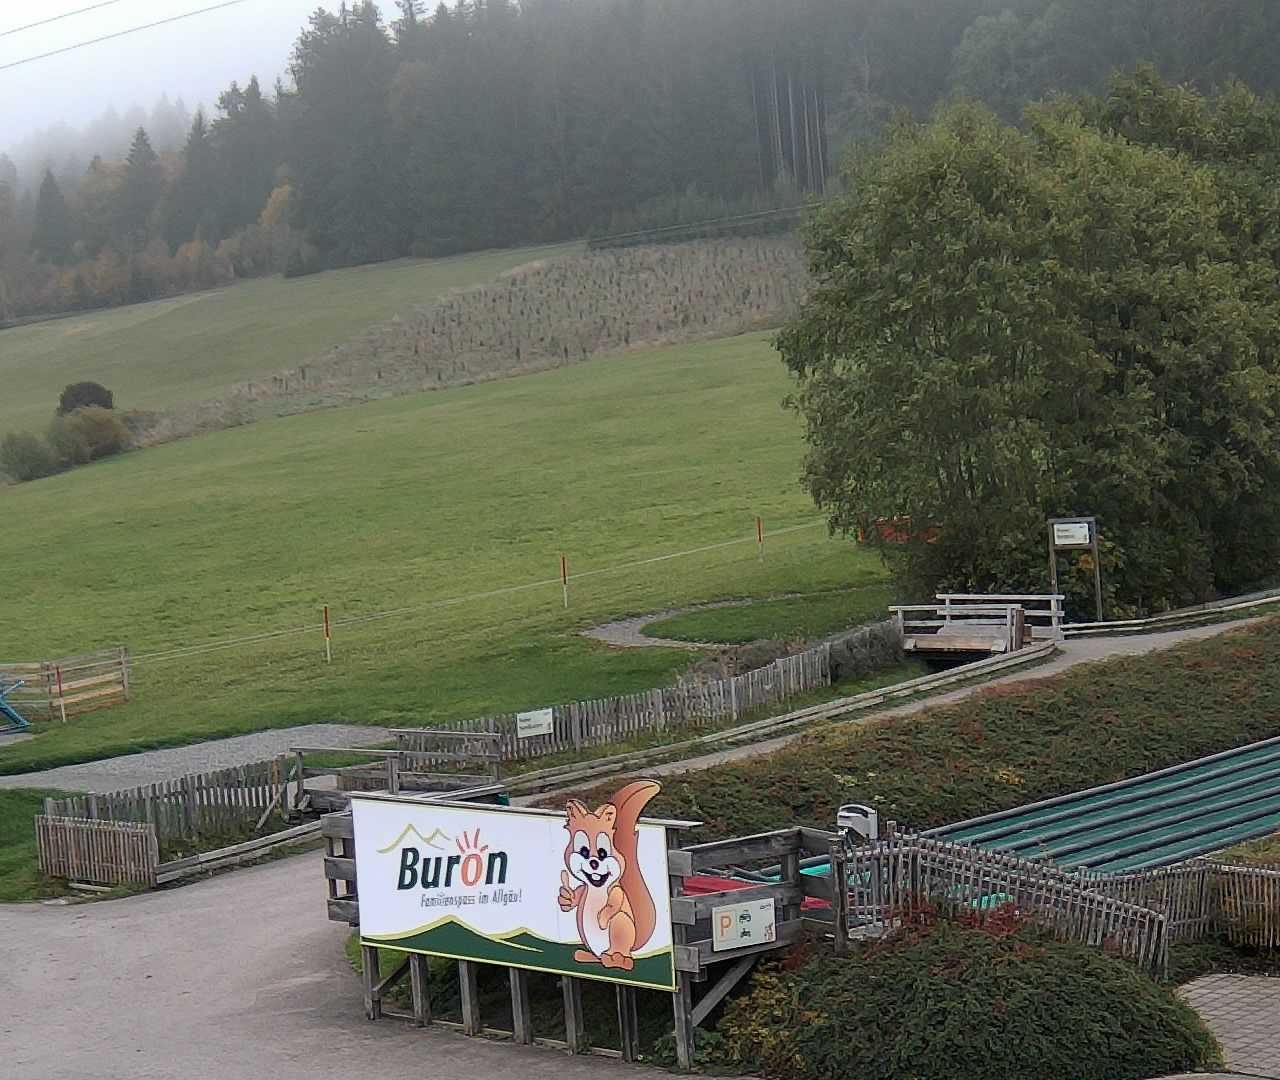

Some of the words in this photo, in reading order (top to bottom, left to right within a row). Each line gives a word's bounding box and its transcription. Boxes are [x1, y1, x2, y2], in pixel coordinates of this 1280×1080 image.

[397, 847, 508, 890] Buron
[479, 892, 489, 904] im
[721, 916, 731, 936] P
